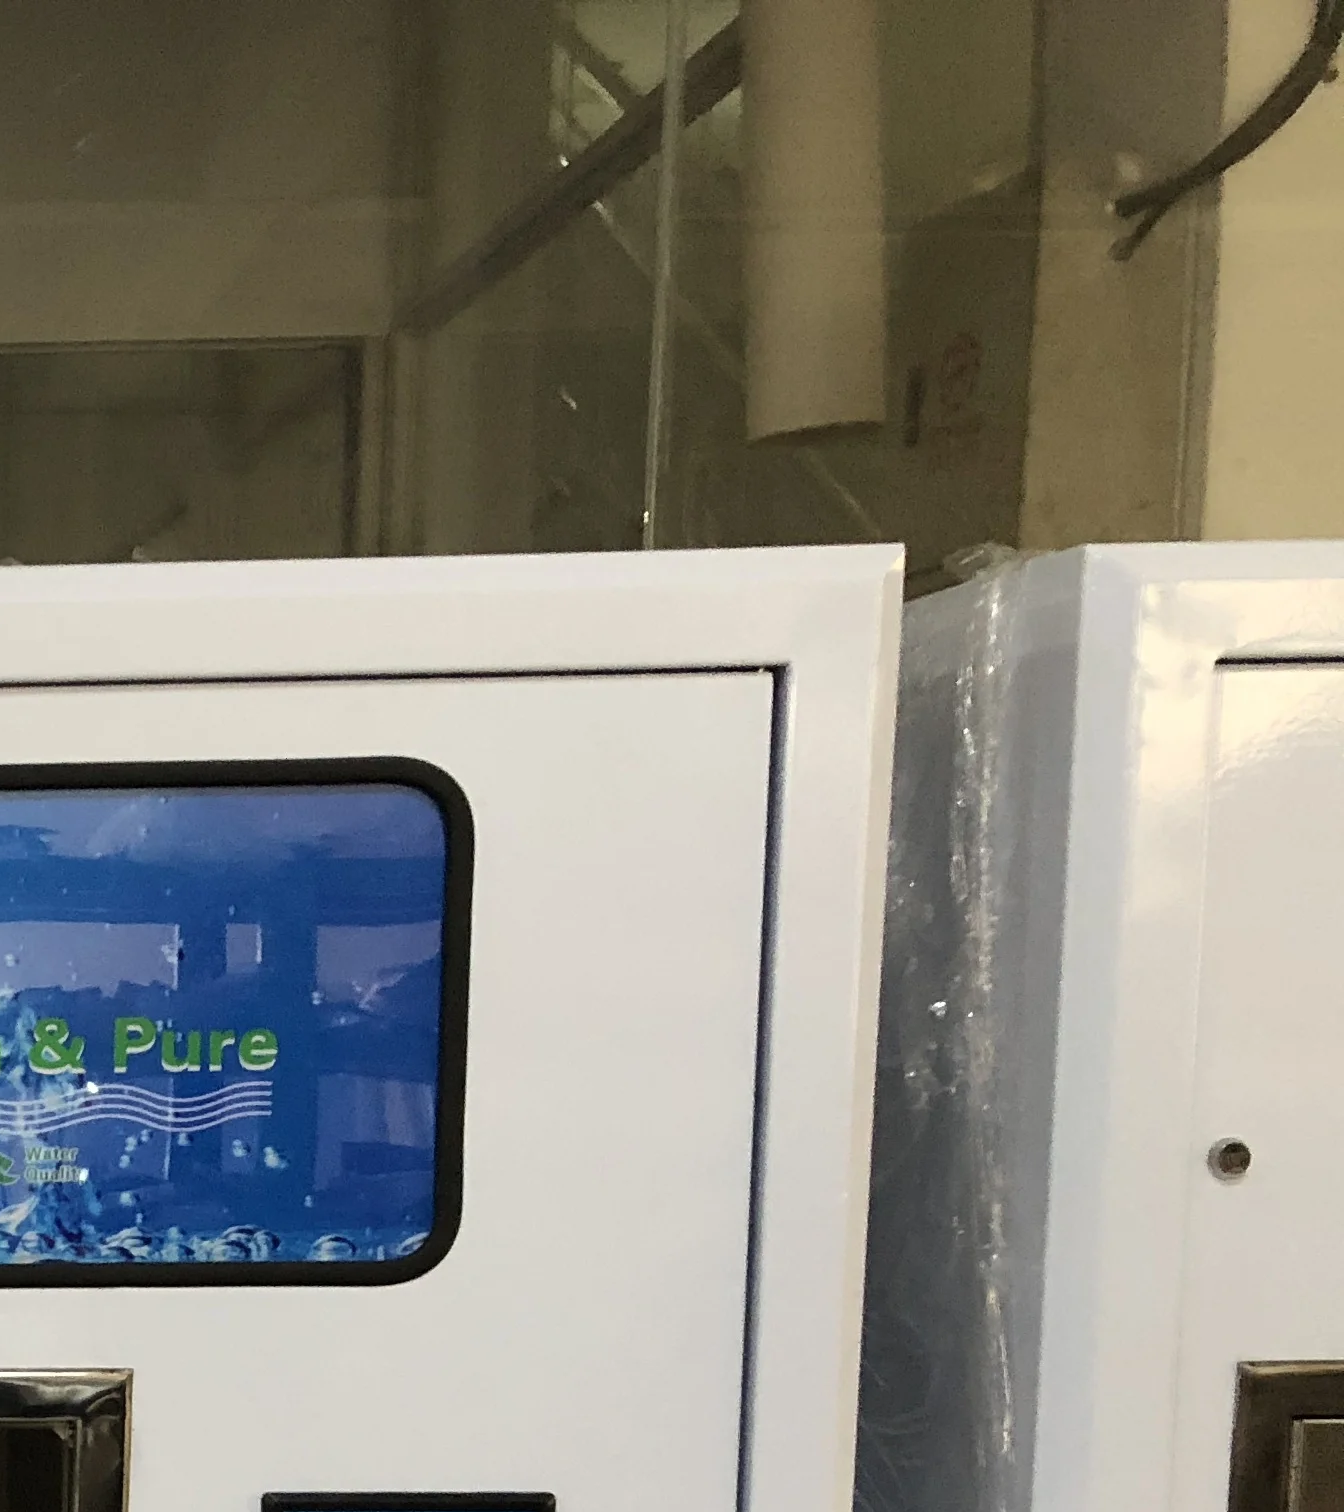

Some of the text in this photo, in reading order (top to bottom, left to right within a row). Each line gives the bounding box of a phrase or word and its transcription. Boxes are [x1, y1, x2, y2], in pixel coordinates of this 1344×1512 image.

[29, 1016, 86, 1075] &
[114, 1015, 278, 1074] Pure
[24, 1146, 79, 1163] Water
